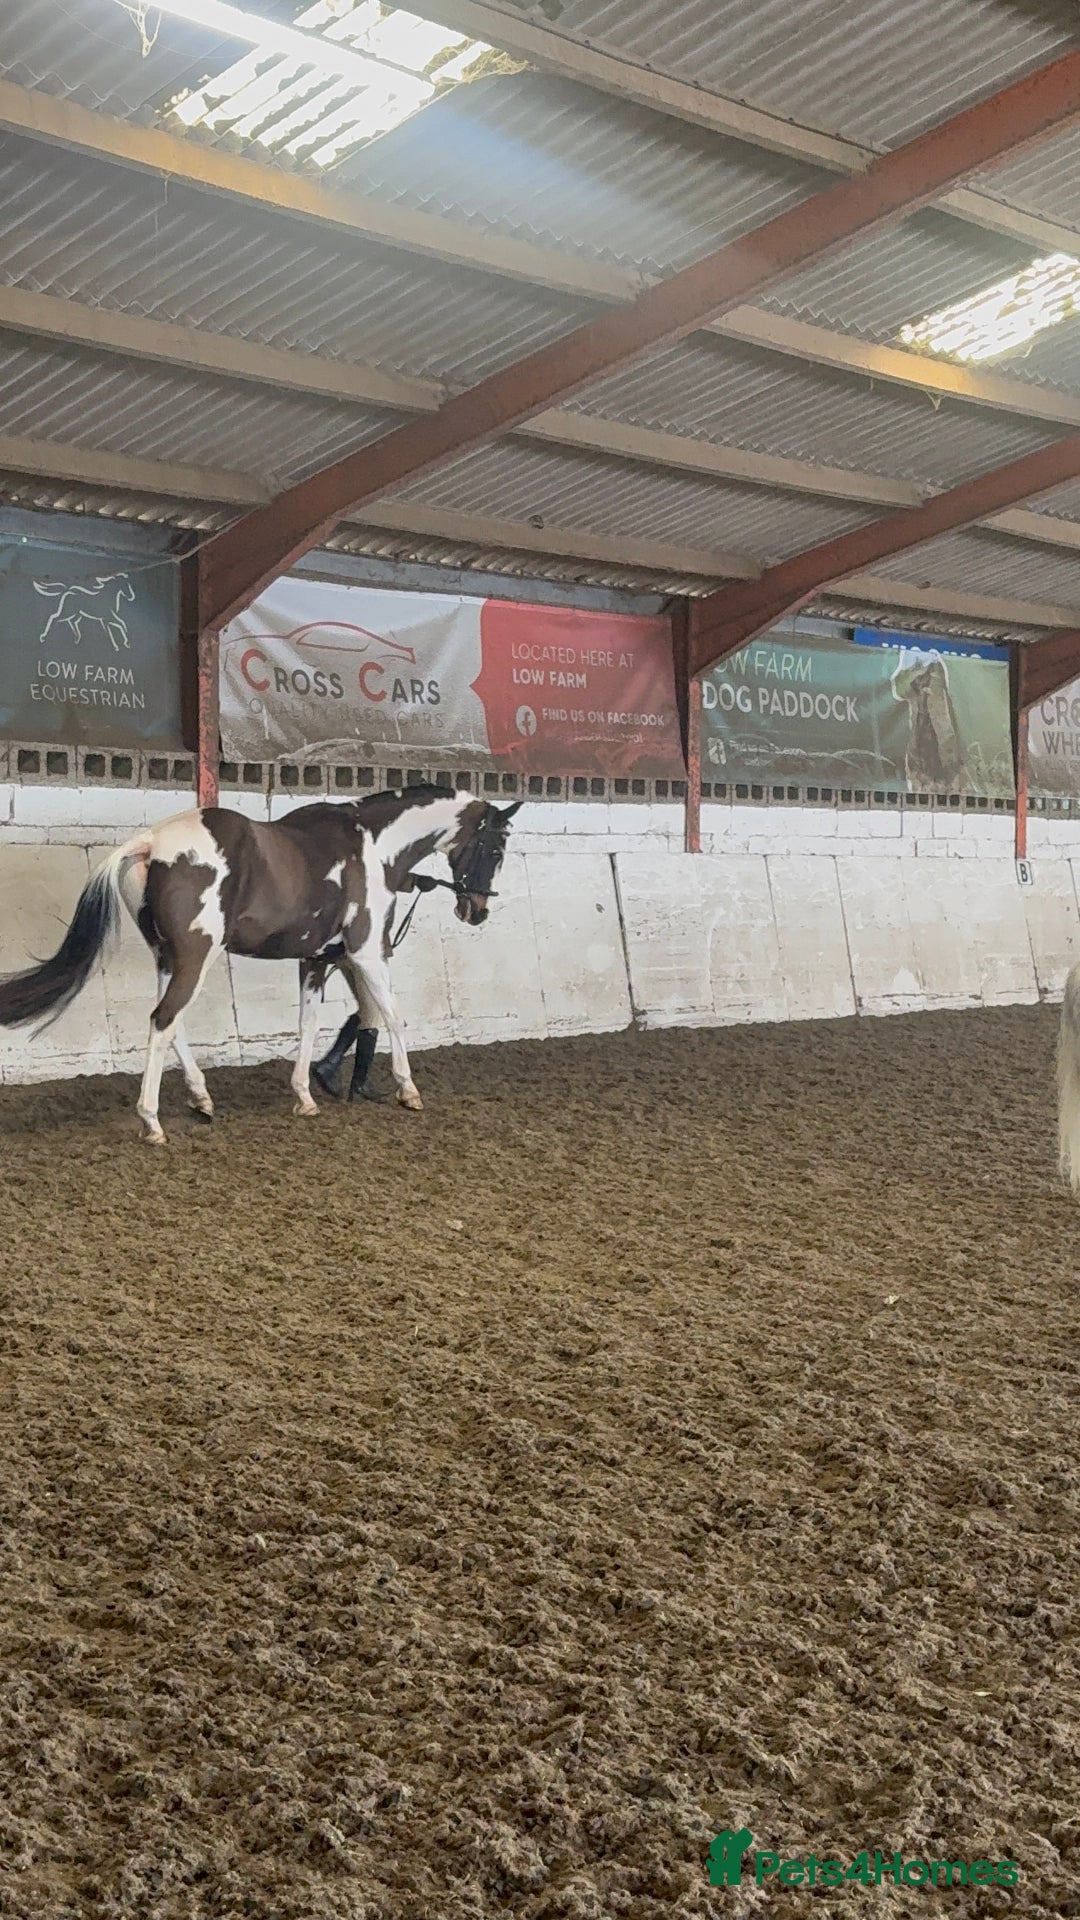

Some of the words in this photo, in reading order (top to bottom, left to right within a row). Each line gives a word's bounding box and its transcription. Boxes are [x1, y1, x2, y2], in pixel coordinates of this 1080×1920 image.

[511, 642, 576, 665] LOCATED
[580, 650, 615, 668] HERE
[618, 653, 634, 669] AT
[754, 650, 812, 682] FARM
[37, 660, 78, 680] LOW
[84, 665, 135, 686] FARM
[240, 649, 344, 699] CROSS
[358, 661, 442, 705] CARS
[512, 668, 545, 686] LOW
[549, 671, 588, 689] FARM
[30, 683, 146, 709] EQUESTRIAN
[702, 679, 753, 714] DOG
[757, 687, 860, 723] PADDOCK
[542, 707, 568, 722] FIND
[570, 708, 585, 722] US
[587, 710, 605, 723] ON
[607, 711, 665, 727] FACEBOOK
[1018, 863, 1029, 883] B
